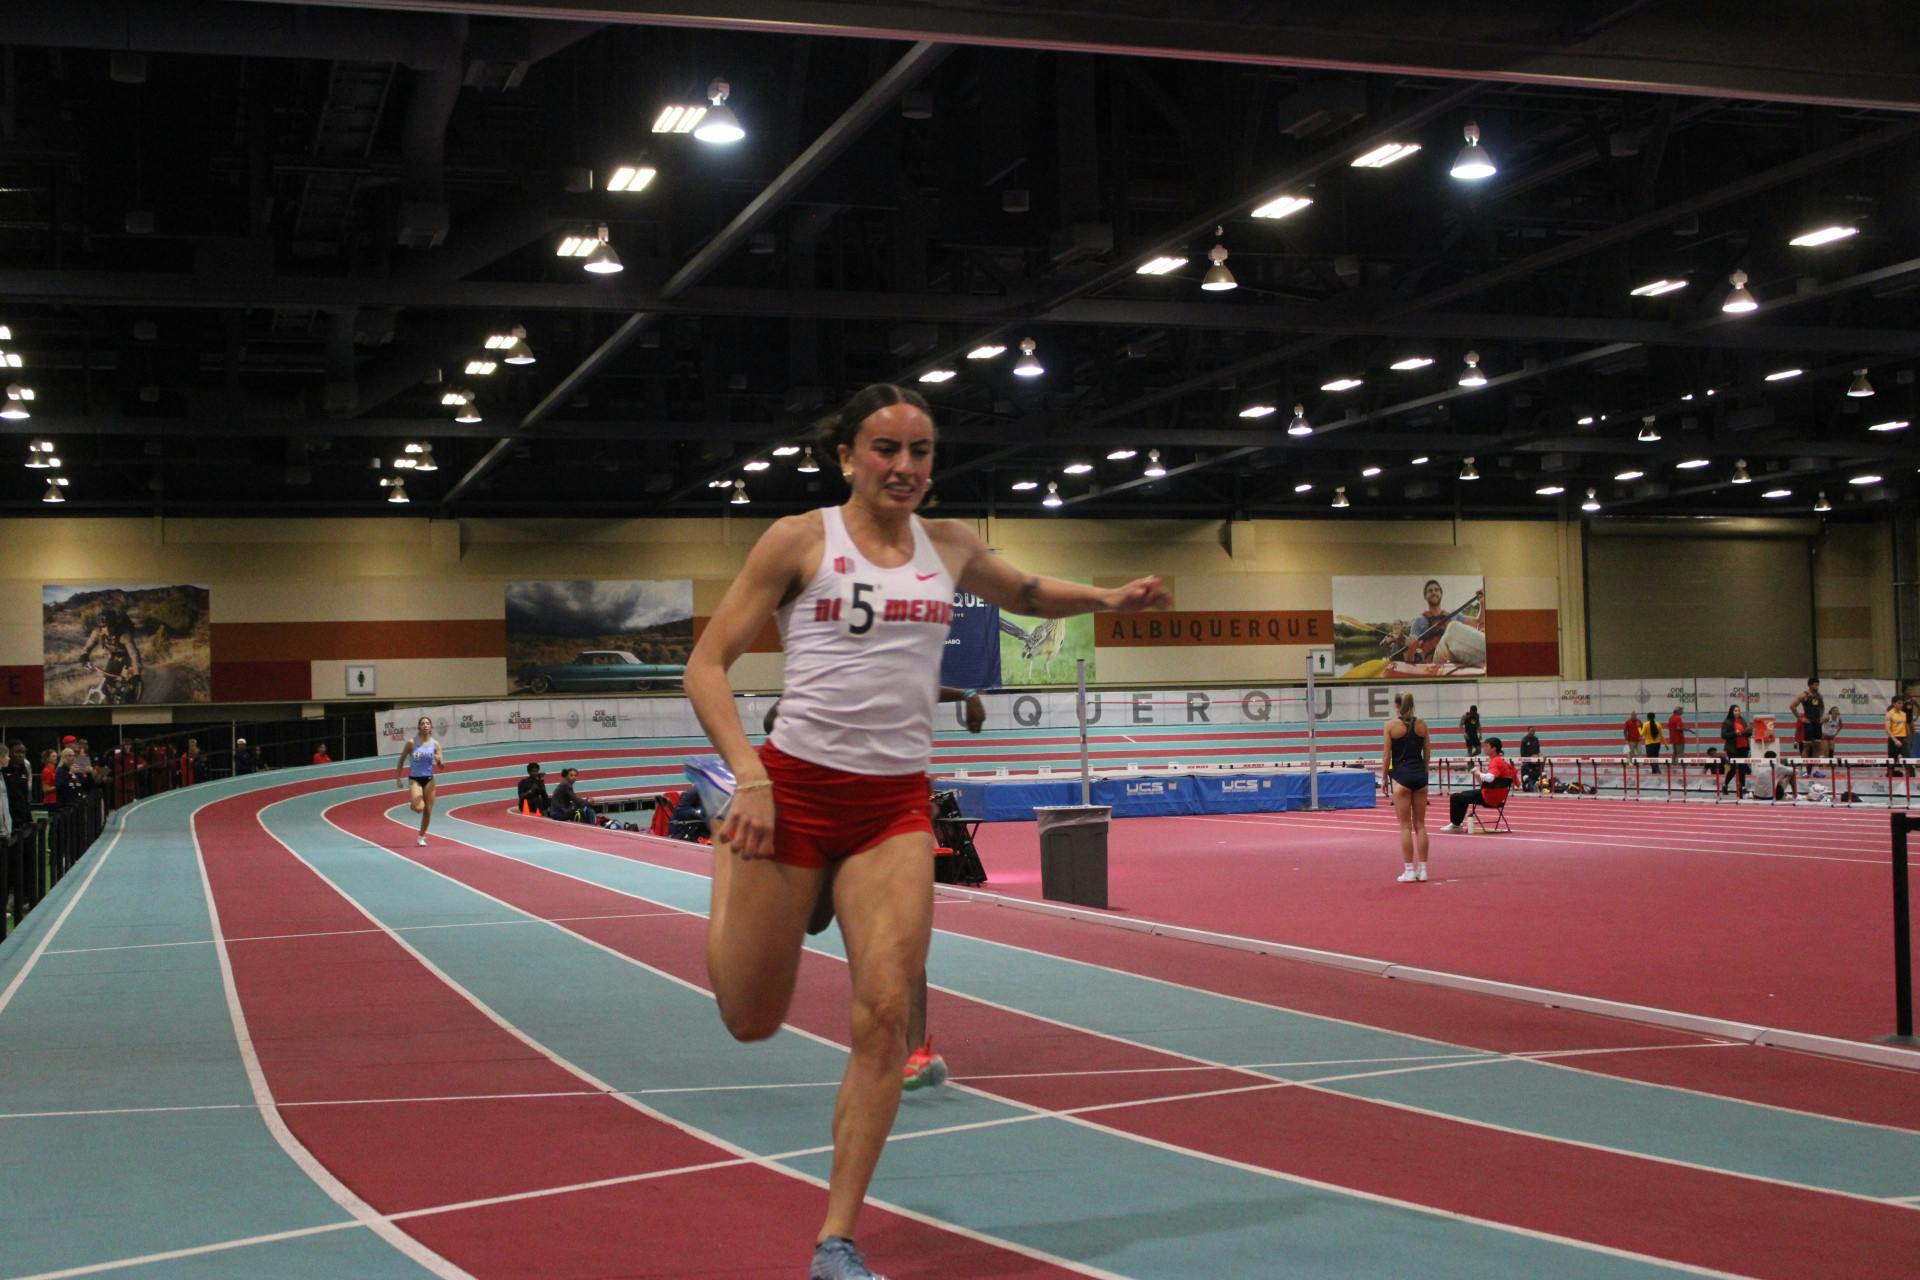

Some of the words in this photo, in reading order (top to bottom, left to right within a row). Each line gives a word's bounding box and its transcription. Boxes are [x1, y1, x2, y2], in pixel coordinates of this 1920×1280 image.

[848, 582, 875, 635] 5
[1112, 618, 1319, 641] ALBUQUERQUE
[1126, 782, 1164, 793] UCS
[1222, 780, 1258, 790] UCS
